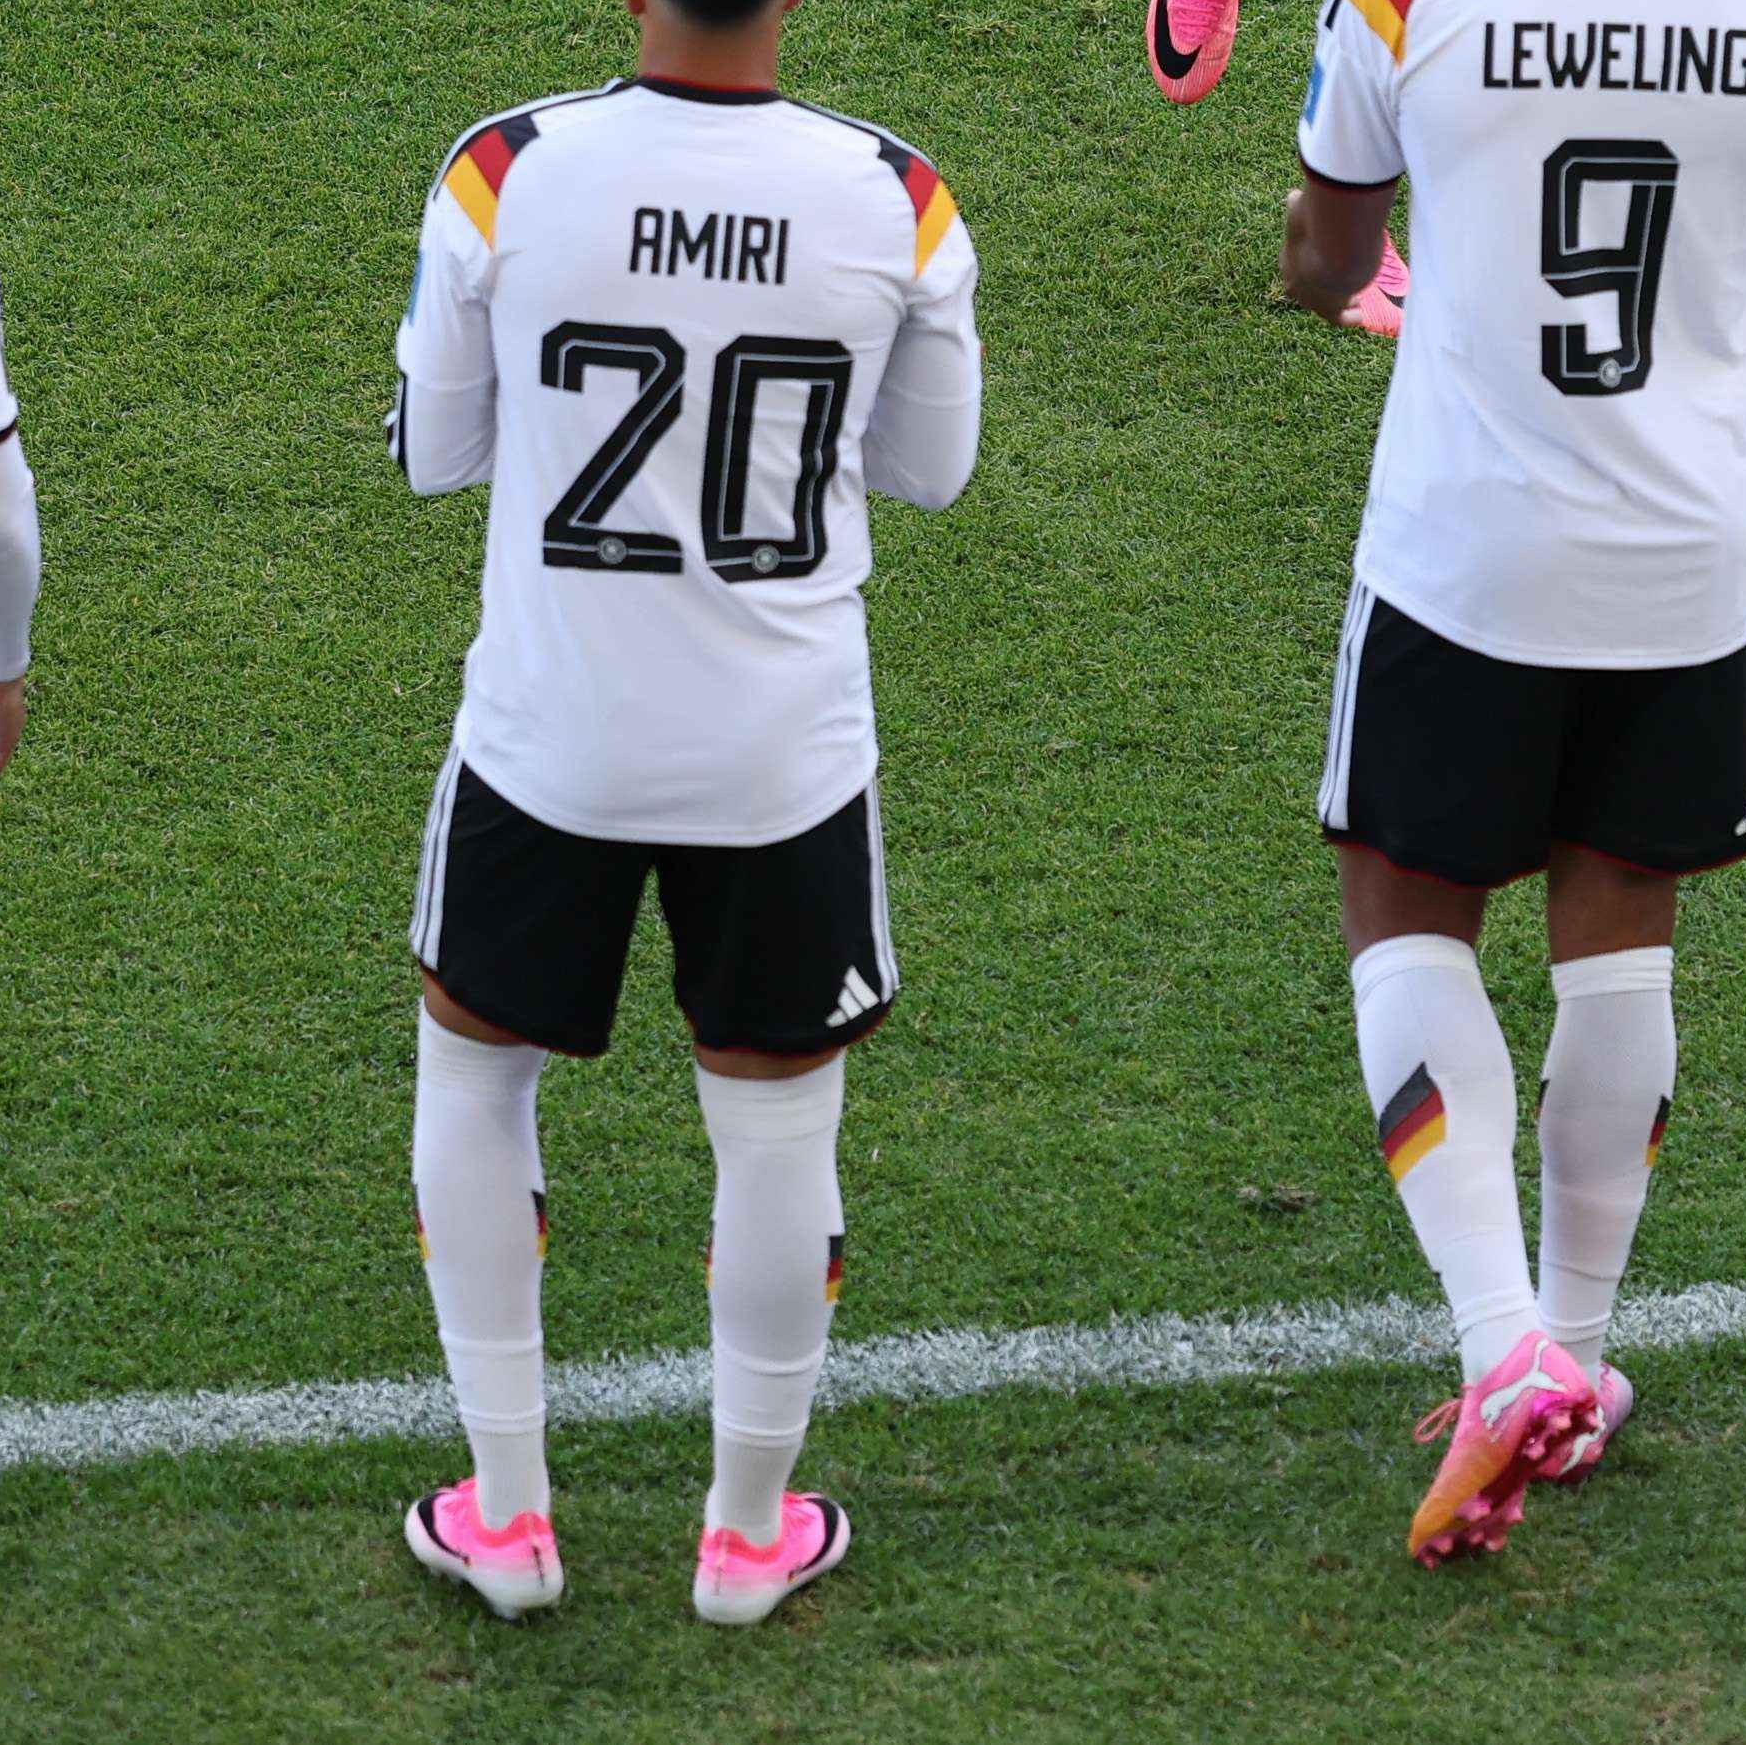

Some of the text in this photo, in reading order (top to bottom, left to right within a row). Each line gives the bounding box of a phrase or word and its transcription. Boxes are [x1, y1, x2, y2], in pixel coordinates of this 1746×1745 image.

[630, 208, 788, 284] AMIRI
[1541, 139, 1679, 396] 9
[541, 321, 853, 583] 20
